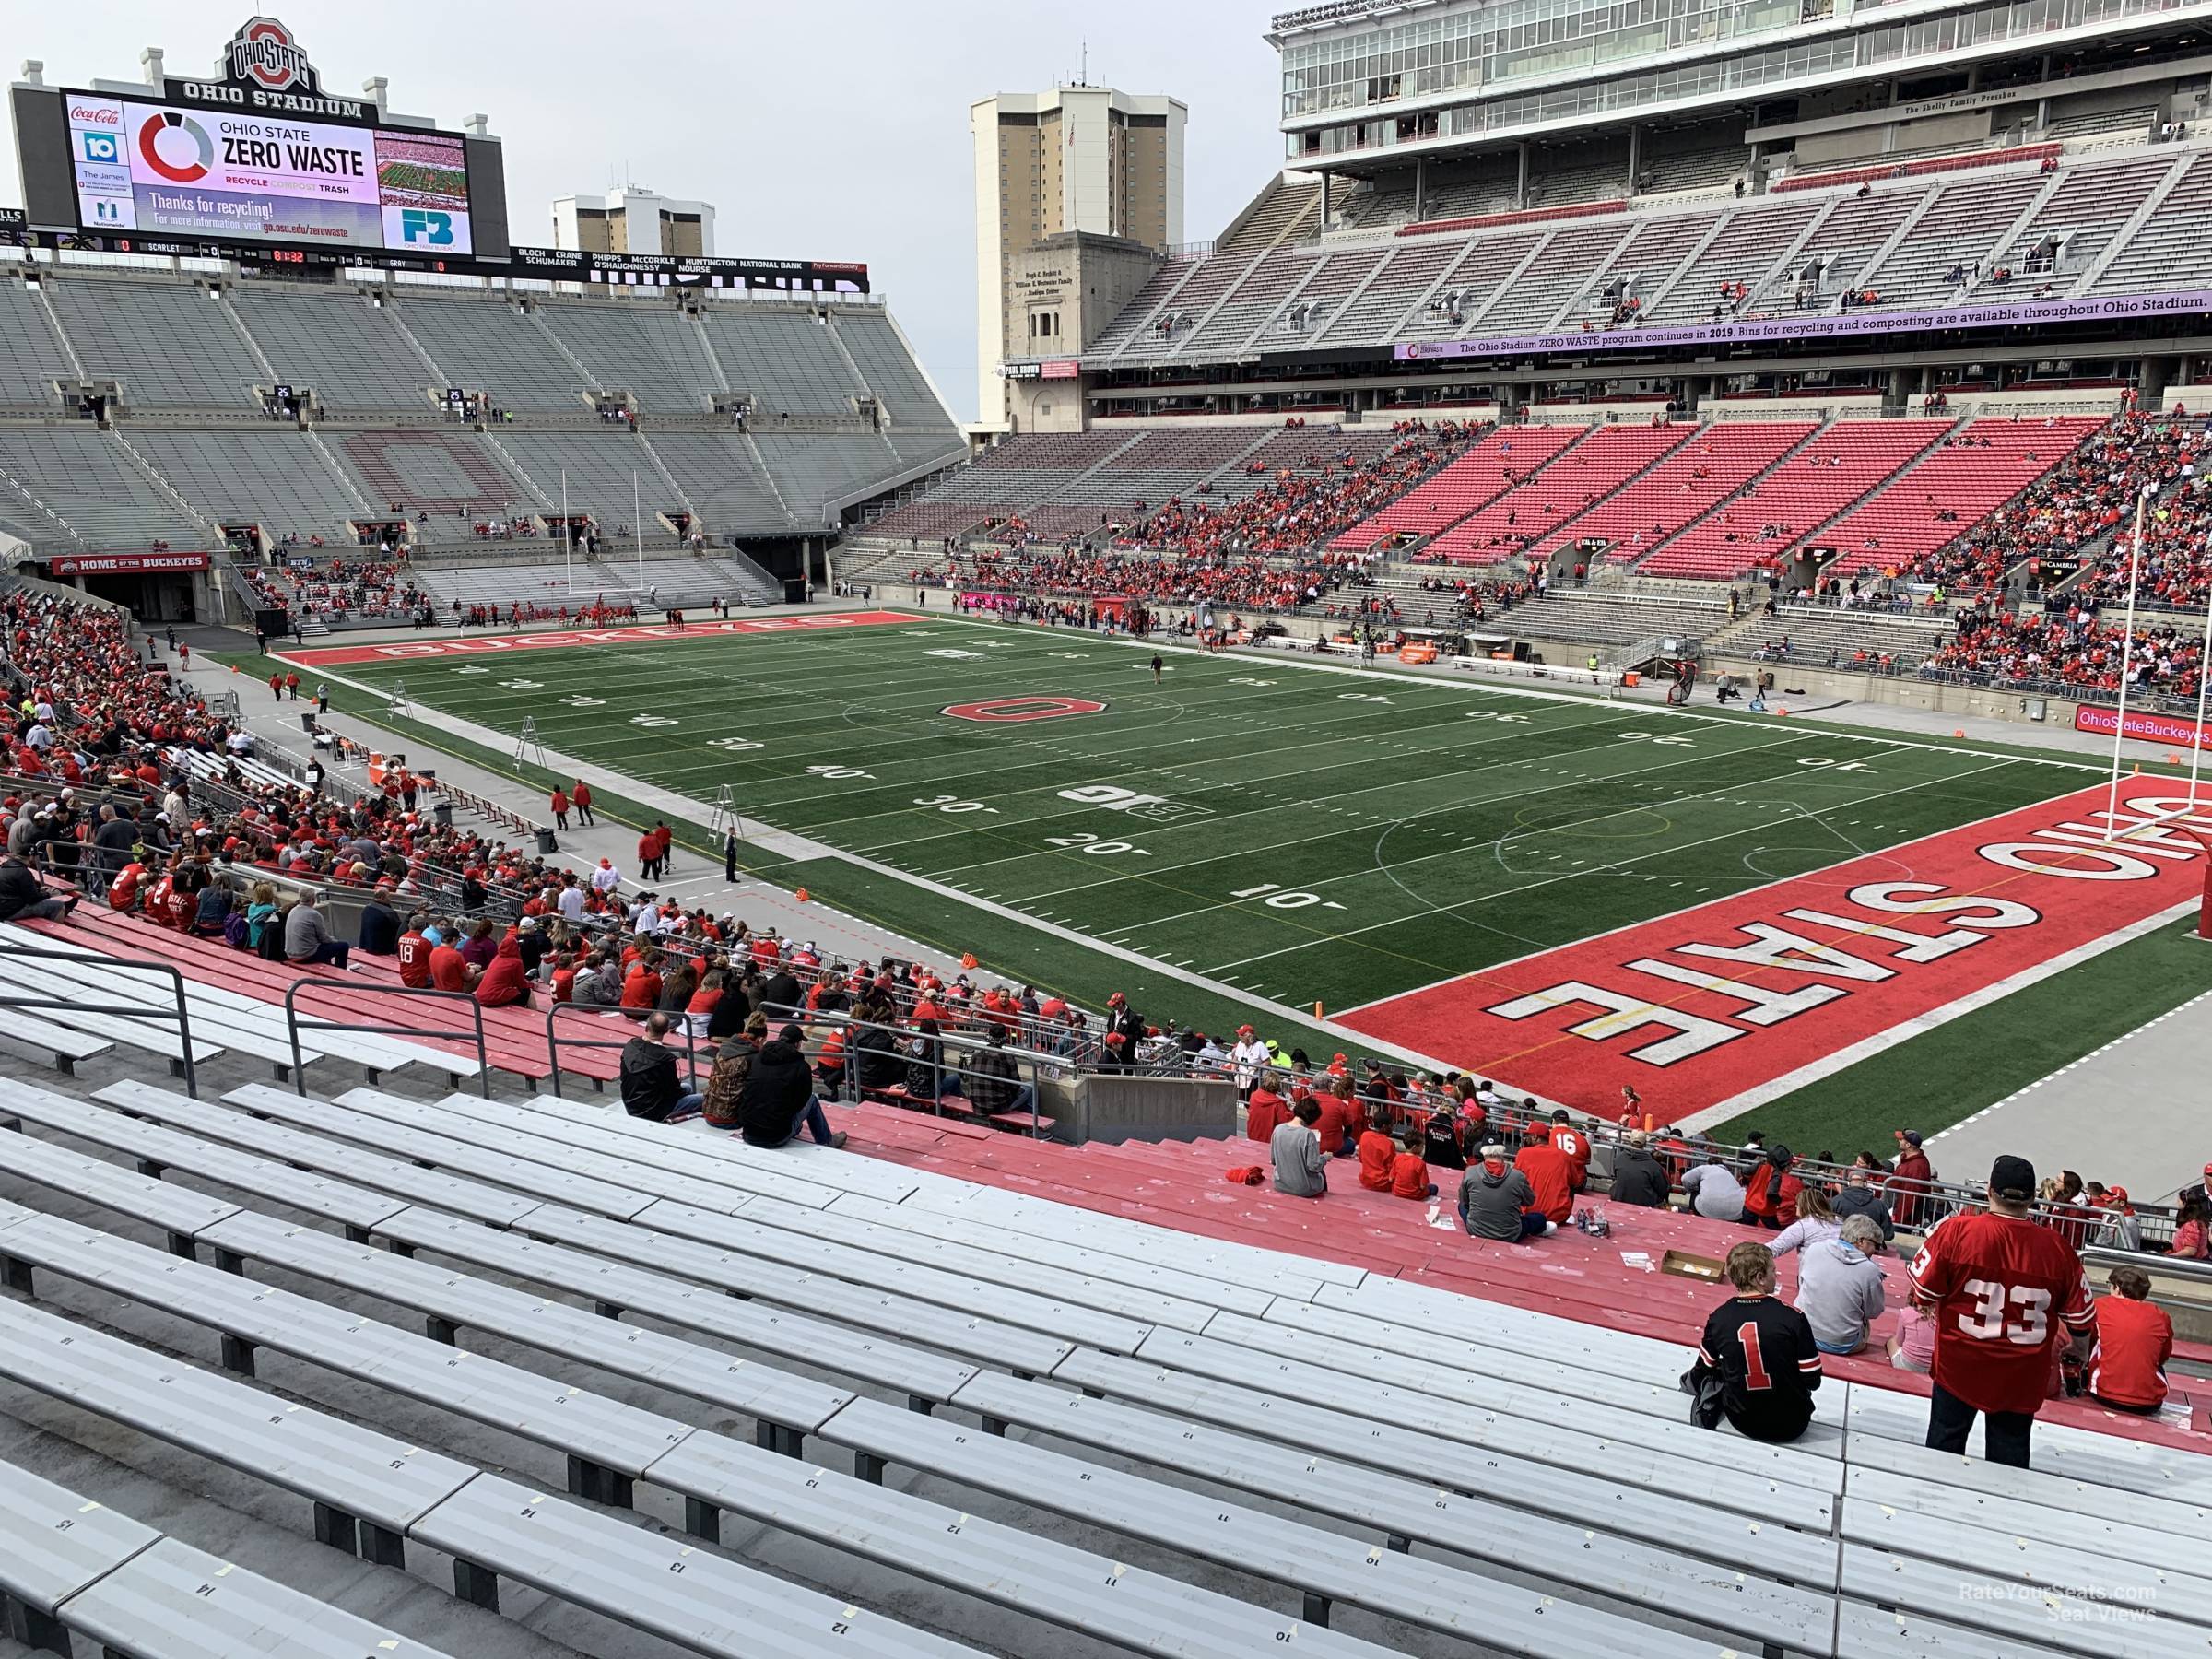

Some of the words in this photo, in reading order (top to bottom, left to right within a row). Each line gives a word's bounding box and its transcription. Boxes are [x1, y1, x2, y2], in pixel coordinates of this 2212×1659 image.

[235, 42, 265, 79] OHIO
[265, 39, 310, 89] STATE
[183, 82, 244, 103] OHIO
[253, 90, 362, 119] STADIUM
[1905, 106, 1919, 114] The
[1923, 101, 1946, 111] Shelly
[1950, 97, 1977, 107] Family
[1981, 91, 2017, 103] Pressbox
[71, 106, 120, 124] Coca-Cola
[220, 121, 261, 136] OHIO
[265, 127, 310, 142] STATE
[87, 137, 114, 158] 10
[221, 137, 284, 169] ZERO
[287, 144, 364, 177] WASTE
[84, 171, 99, 179] The
[100, 172, 124, 181] James
[226, 176, 268, 187] RECYCLE
[271, 180, 317, 192] COMPOST
[319, 184, 349, 194] TRASH
[149, 192, 194, 212] Thanks
[196, 196, 214, 213] for
[218, 200, 274, 219] recycling!
[154, 213, 168, 225] For
[170, 216, 192, 226] more
[194, 216, 242, 230] information,
[243, 221, 262, 231] visit
[264, 223, 348, 238] go.osu.edu/zerowaste
[147, 242, 180, 253] SCARLET
[390, 259, 406, 267] GRAY
[518, 248, 546, 257] BLOCH
[556, 251, 582, 260] CRANE
[593, 253, 622, 263] PHIPPS
[631, 256, 675, 265] McCORKLE
[685, 257, 737, 267] HUNTINGTON
[740, 260, 779, 269] NATIONAL
[781, 262, 803, 270] BANK
[525, 257, 578, 267] SCHUMAKER
[594, 261, 660, 272] O'SHAUGHNESSY
[678, 265, 711, 274] NOURSE
[1460, 344, 1476, 353] The
[1478, 343, 1499, 351] Ohio
[1501, 340, 1536, 350] Stadium
[1539, 338, 1564, 348] ZERO
[1566, 336, 1600, 347] WASTE
[1602, 335, 1643, 347] program
[1646, 332, 1693, 342] continues
[1696, 330, 1705, 339] in
[1710, 328, 1735, 338] 2019.
[1738, 326, 1760, 336] Bins
[1763, 325, 1779, 335] for
[1782, 323, 1834, 335] recycling
[1838, 320, 1859, 330] and
[1863, 315, 1933, 330] composting
[1936, 313, 1957, 324] are
[1960, 310, 2019, 323] available
[2024, 304, 2100, 320] throughout
[2103, 301, 2138, 312] Ohio
[2142, 298, 2207, 311] Stadium.
[79, 559, 117, 571] HOME
[143, 557, 203, 568] BUCKEYES
[382, 617, 855, 658] BUCKEYES
[707, 736, 766, 751] 50
[805, 763, 864, 780] 40
[912, 794, 986, 814] 30
[1043, 832, 1135, 856] 20
[112, 869, 129, 891] 2
[153, 881, 168, 905] 2
[1229, 883, 1322, 910] 10
[399, 944, 414, 963] 18
[1479, 879, 2044, 1068] STATE
[549, 979, 559, 1000] 2
[1429, 1127, 1453, 1141] MARCHING
[1556, 1133, 1577, 1156] 16
[1910, 1244, 1932, 1278] 3
[1958, 1278, 2052, 1345] 33
[1736, 1321, 1772, 1391] 1
[389, 1460, 405, 1469] 15
[806, 1479, 818, 1488] 13
[521, 1506, 536, 1518] 14
[1436, 1500, 1447, 1508] 10
[55, 1520, 74, 1531] 15
[947, 1524, 961, 1535] 12
[670, 1562, 686, 1573] 13
[1366, 1557, 1379, 1566] 10
[196, 1583, 216, 1596] 14
[1105, 1577, 1117, 1586] 11
[831, 1622, 848, 1634] 12
[1276, 1631, 1290, 1642] 10
